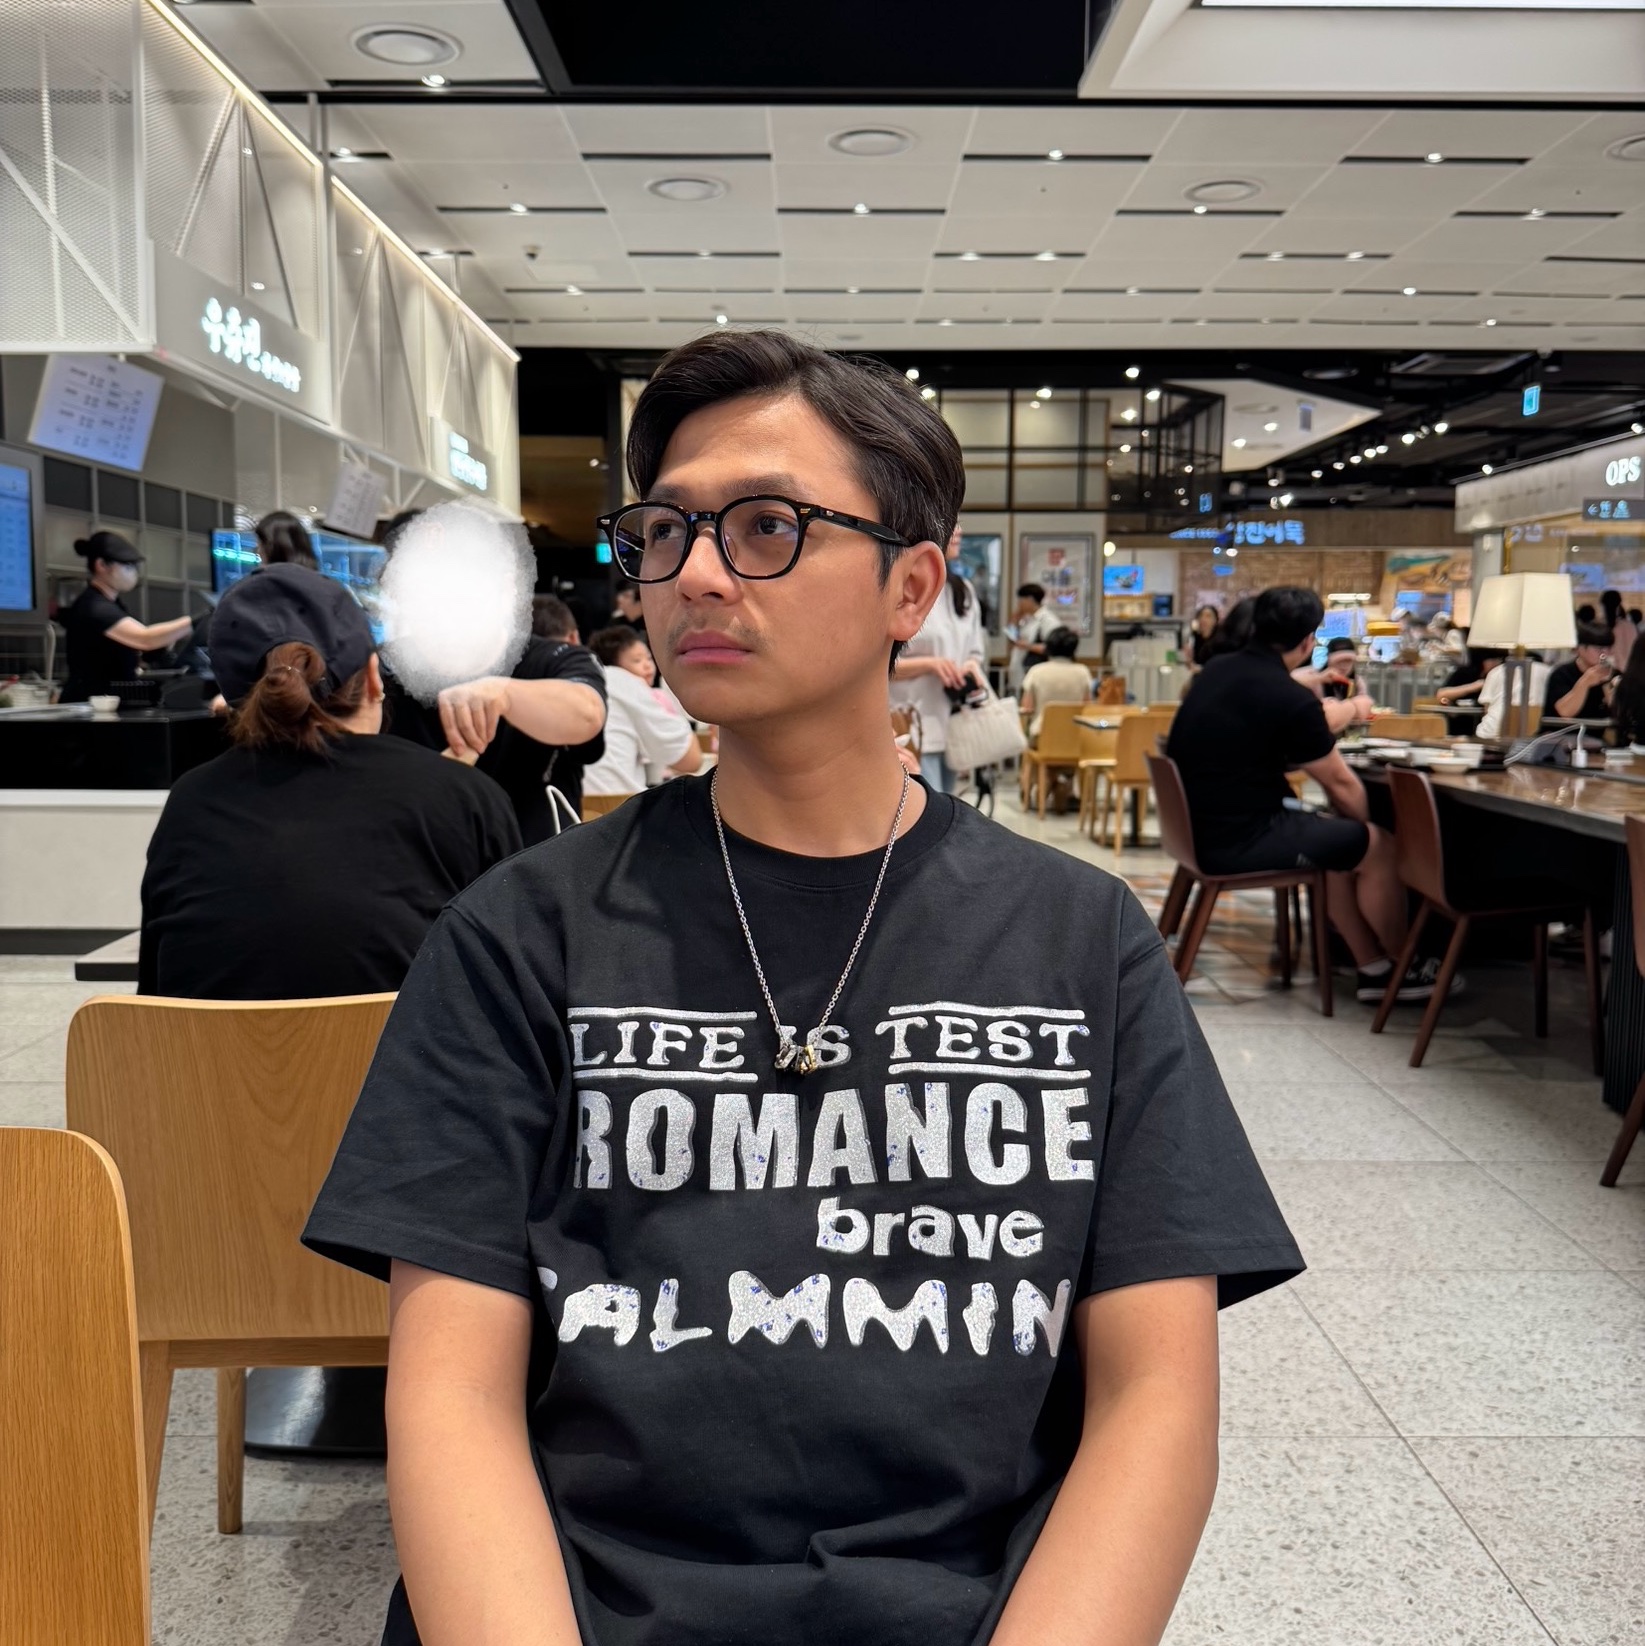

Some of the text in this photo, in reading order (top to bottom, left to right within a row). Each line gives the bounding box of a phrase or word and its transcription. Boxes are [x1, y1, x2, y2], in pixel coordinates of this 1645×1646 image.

[1605, 456, 1641, 486] OPS
[570, 1021, 746, 1069] LIFE
[874, 1015, 1090, 1066] TEST
[573, 1082, 1096, 1191] ROMANCE
[816, 1197, 1045, 1261] brave
[537, 1266, 1071, 1358] ALMMIN
